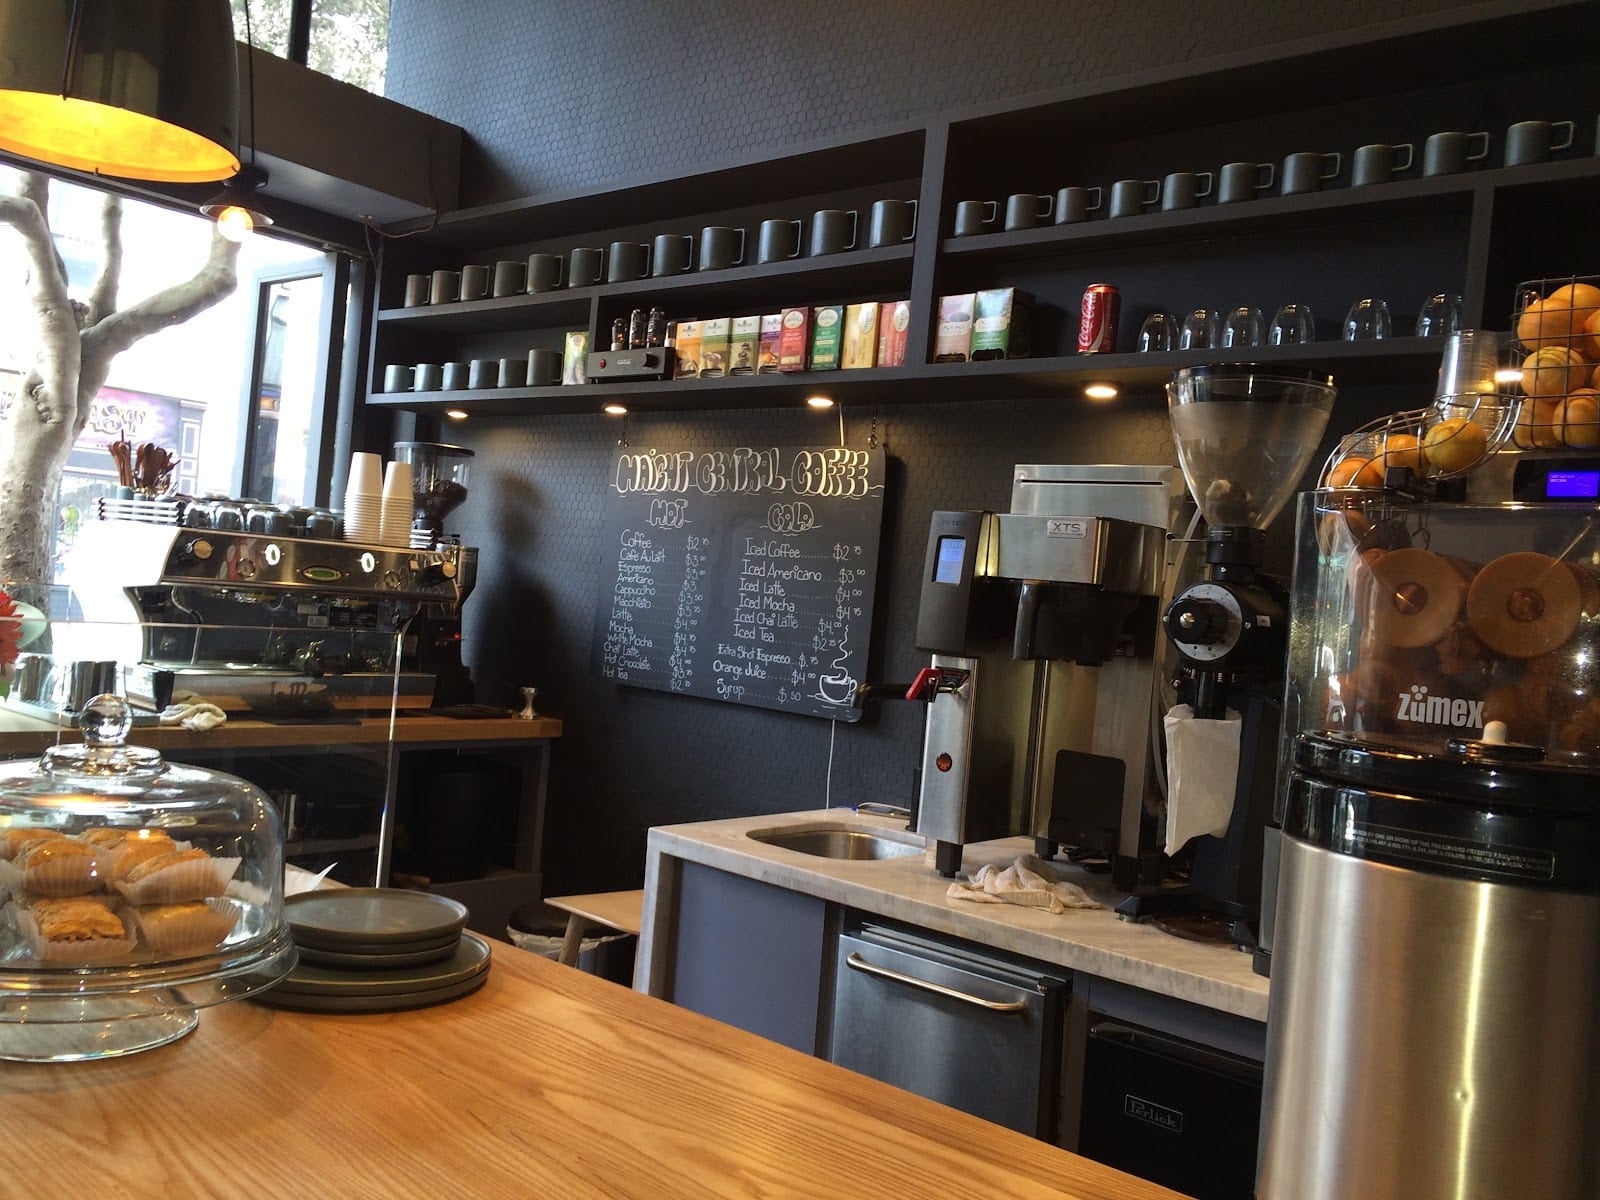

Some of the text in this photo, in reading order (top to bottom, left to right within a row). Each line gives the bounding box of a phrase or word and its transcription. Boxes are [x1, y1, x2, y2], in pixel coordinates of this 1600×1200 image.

[791, 448, 869, 497] COFFEE
[649, 499, 688, 528] HOT
[767, 502, 815, 533] COLD
[1053, 522, 1081, 533] XTS
[620, 529, 653, 549] Coffee
[744, 537, 767, 556] Iced
[768, 540, 801, 559] Coffee
[617, 561, 652, 575] Espresso
[741, 559, 766, 577] Iced
[766, 561, 822, 581] Americano
[617, 573, 654, 585] Americano
[738, 577, 760, 592] Iced
[763, 580, 786, 597] Latte
[738, 593, 761, 609] Iced
[763, 596, 795, 612] Mocha
[611, 607, 633, 622] Latte
[734, 608, 755, 623] Iced
[756, 612, 777, 626] Chai
[777, 613, 799, 629] Latte
[609, 620, 634, 635] Mocha
[733, 624, 756, 640] Iced
[758, 626, 775, 643] Tea
[629, 634, 653, 647] Mocha
[717, 643, 736, 657] Extra
[737, 645, 756, 660] Shot
[756, 648, 791, 666] Espresso
[712, 660, 743, 681] Orange
[744, 662, 767, 680] Juice
[716, 678, 745, 700] Syrup
